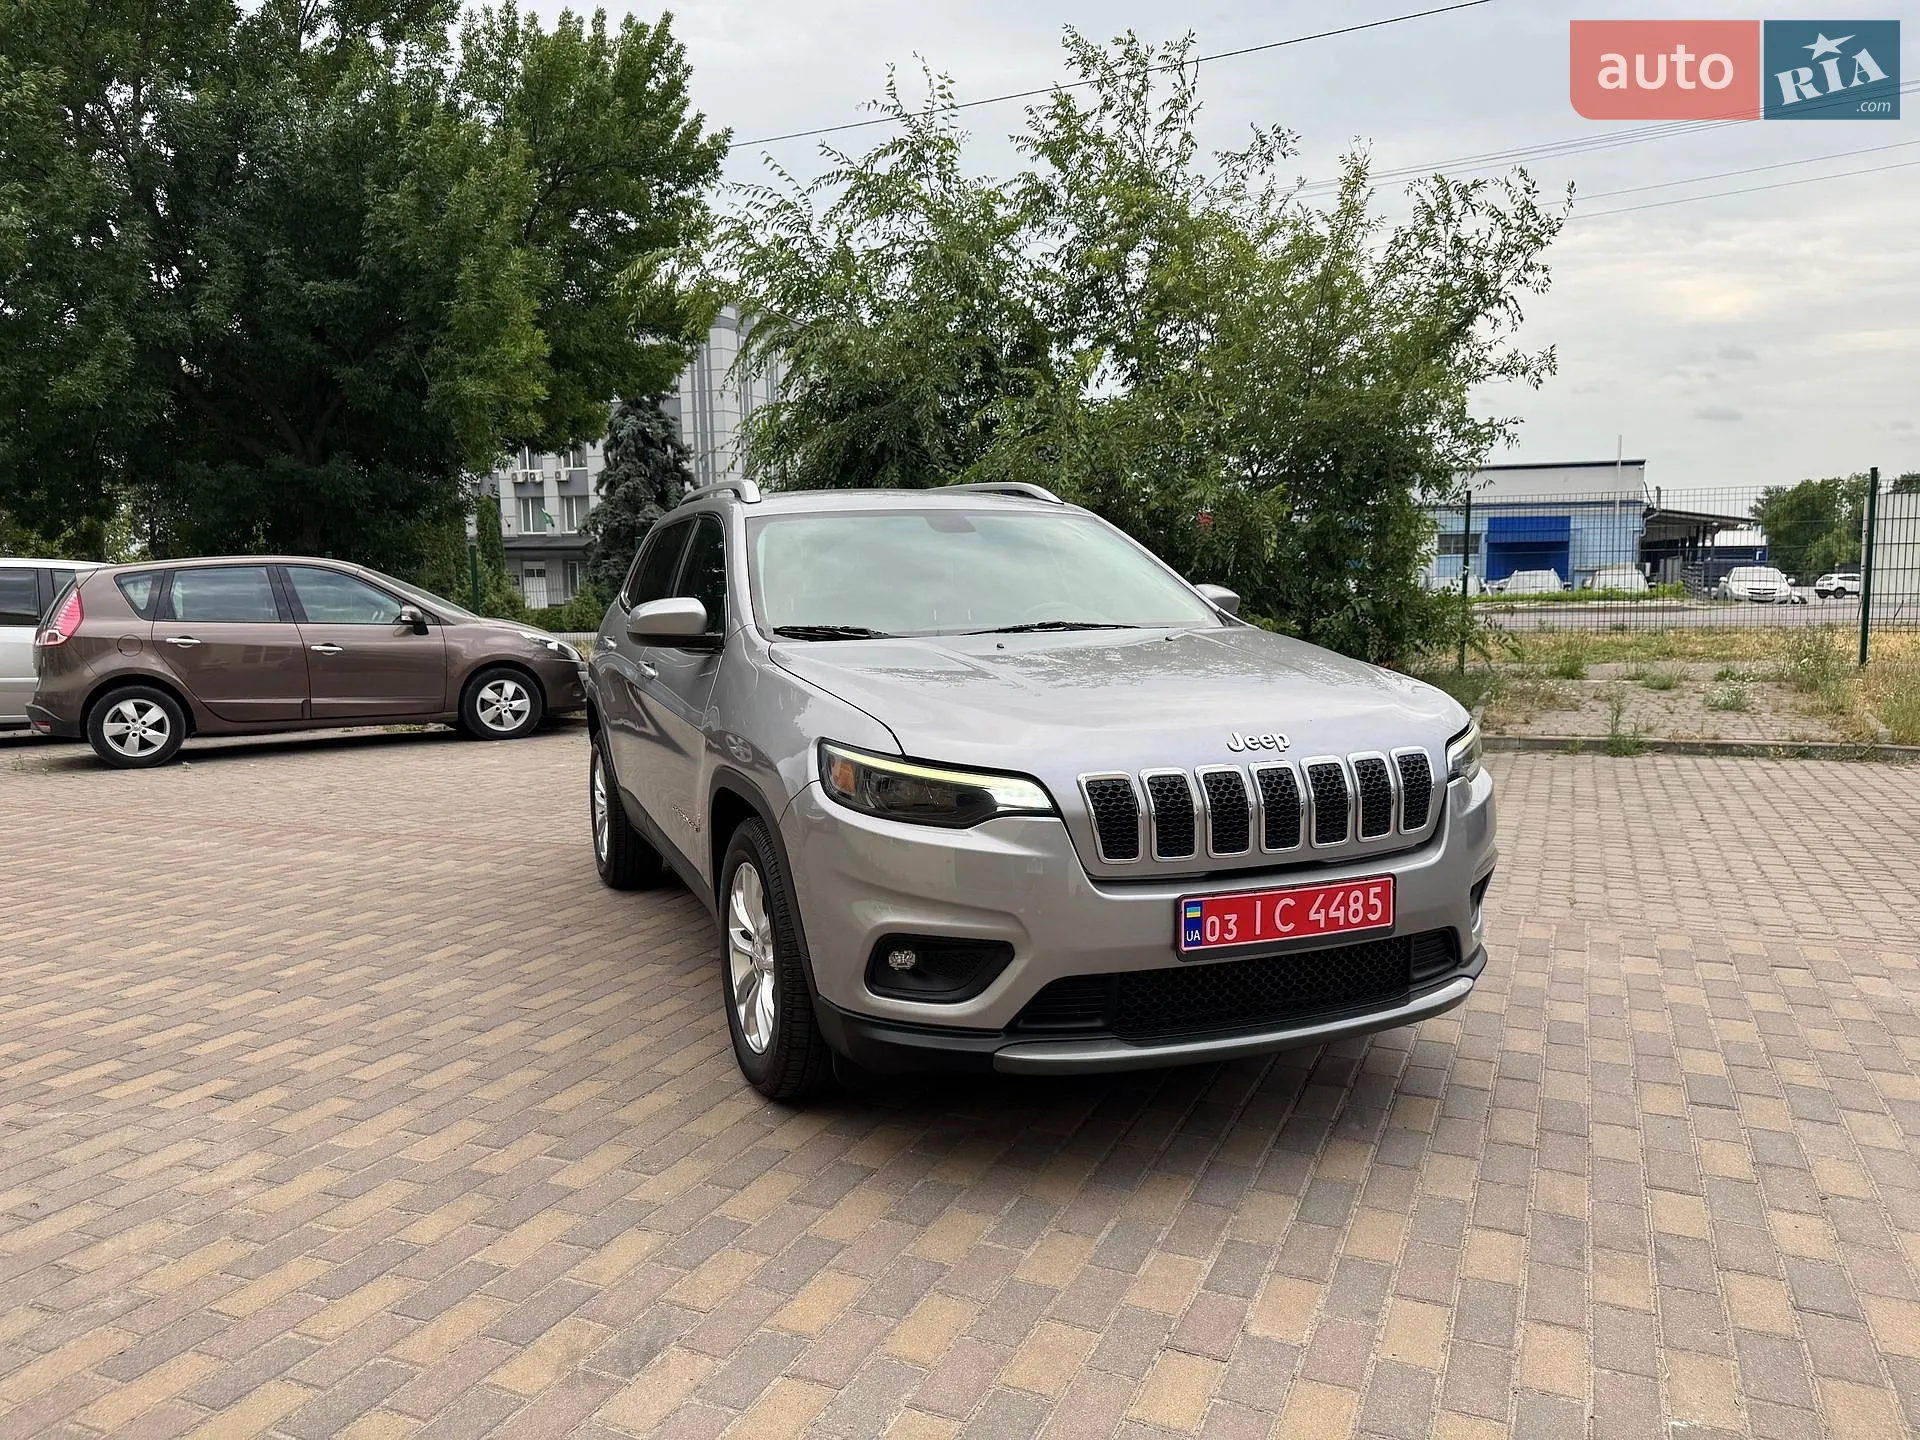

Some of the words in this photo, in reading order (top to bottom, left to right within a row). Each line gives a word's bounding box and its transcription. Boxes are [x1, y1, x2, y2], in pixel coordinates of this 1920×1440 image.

[1226, 731, 1291, 752] Jeep
[1205, 912, 1238, 942] 03
[1308, 886, 1382, 928] 4485
[1186, 930, 1201, 941] UA
